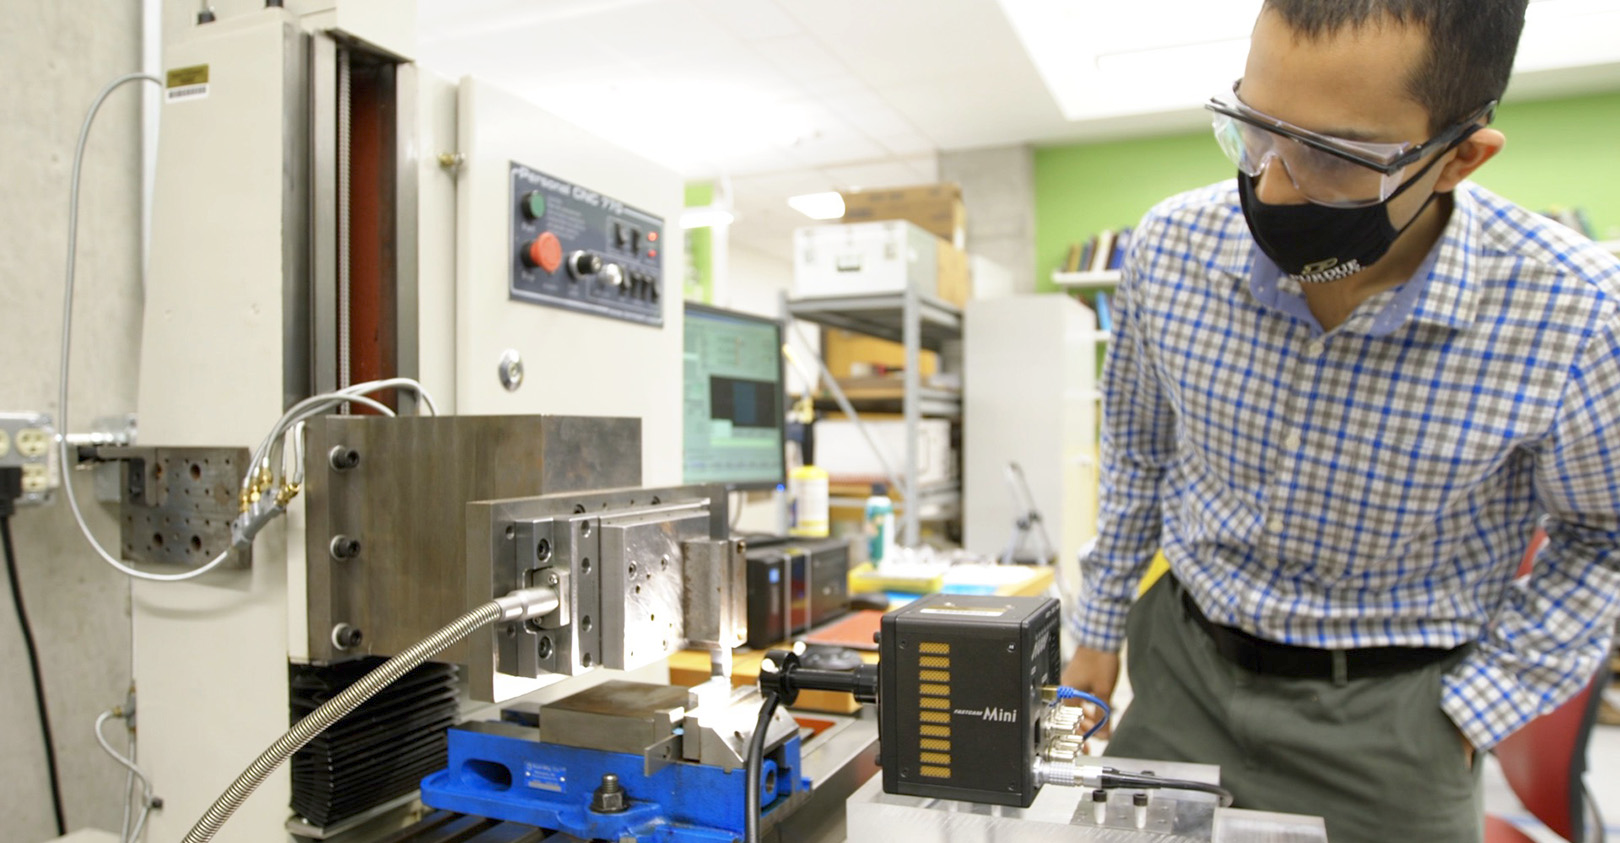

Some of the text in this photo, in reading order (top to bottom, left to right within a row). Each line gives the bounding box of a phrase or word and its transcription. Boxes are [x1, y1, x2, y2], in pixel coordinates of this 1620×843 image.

[518, 166, 571, 198] Personal
[572, 186, 600, 207] CNC
[982, 706, 1017, 723] Mini
